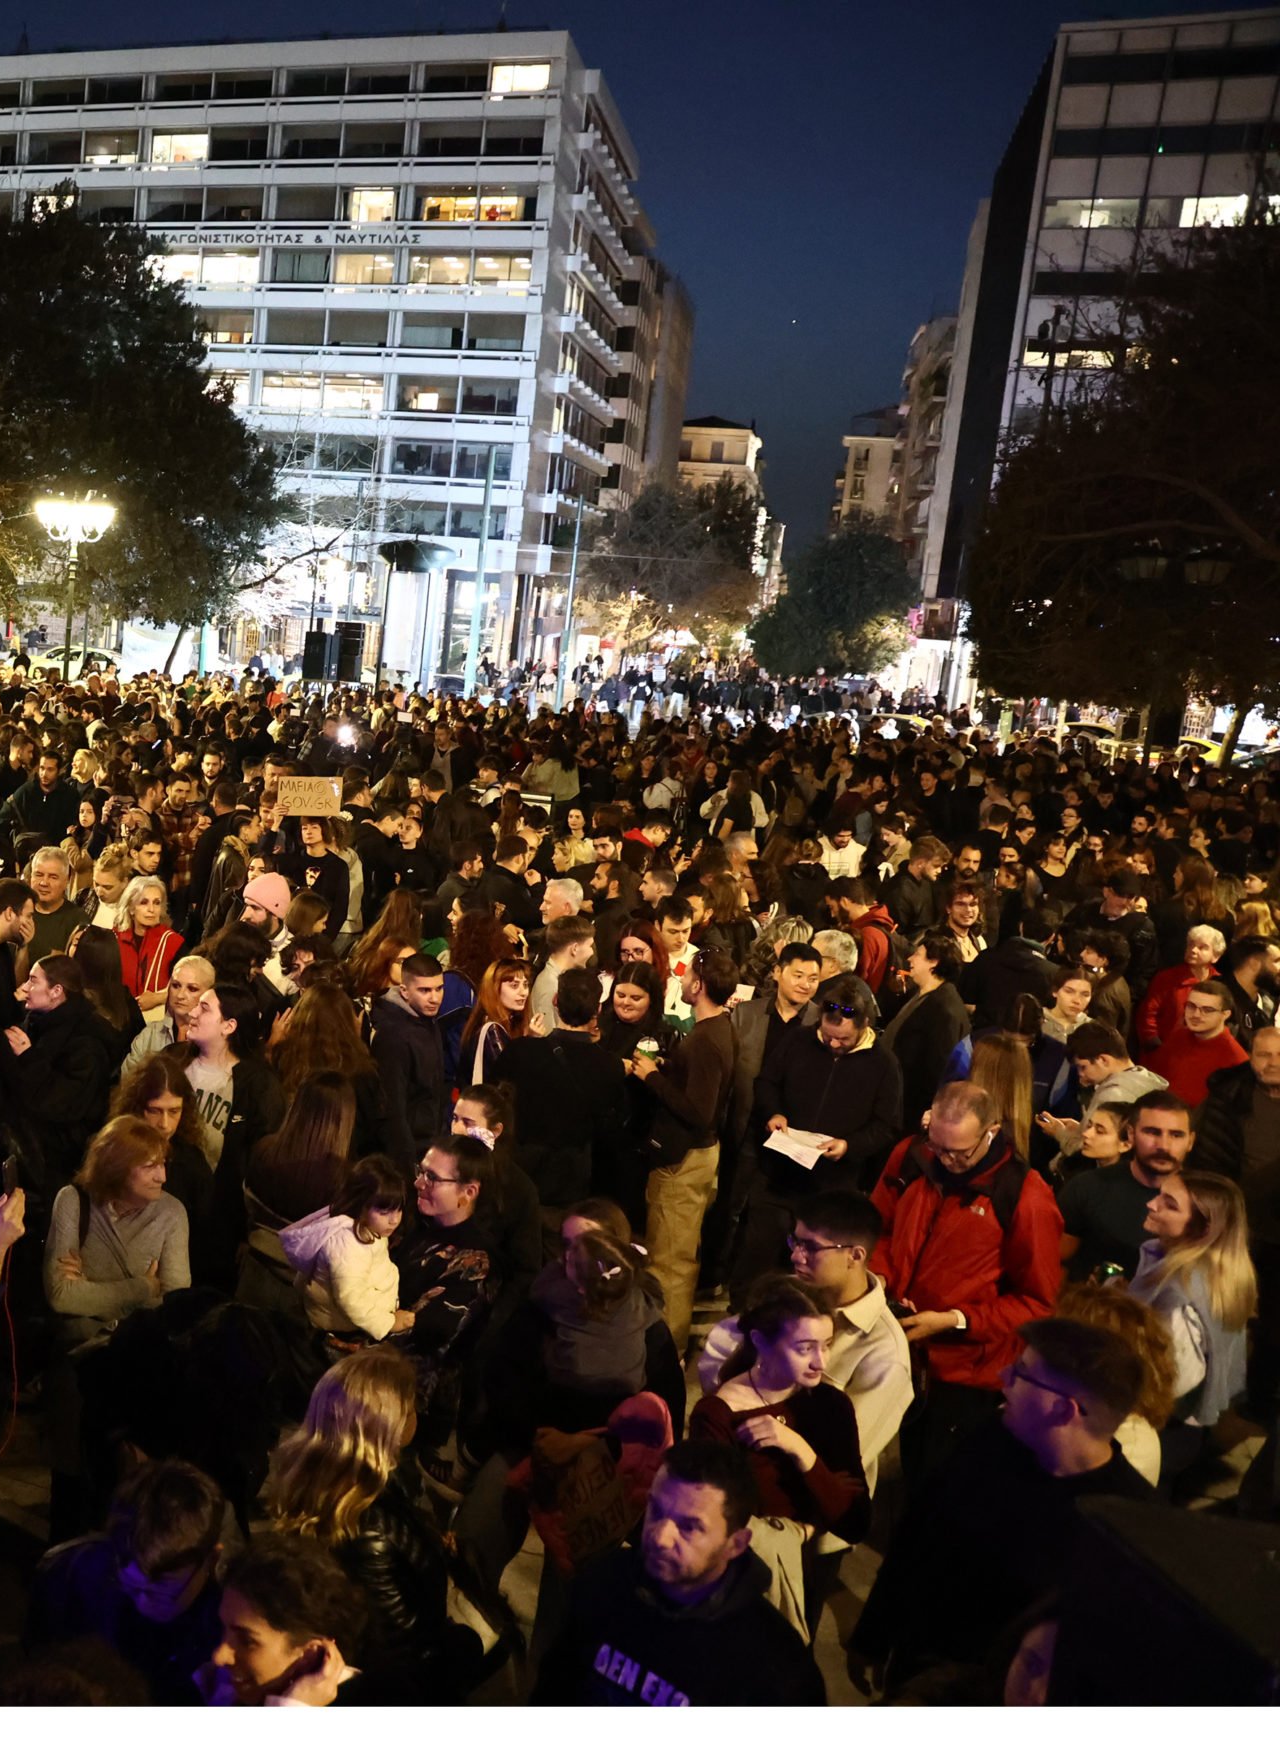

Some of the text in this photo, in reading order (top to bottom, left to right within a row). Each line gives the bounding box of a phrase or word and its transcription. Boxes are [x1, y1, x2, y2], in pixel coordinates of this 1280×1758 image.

[314, 234, 323, 244] &
[335, 233, 421, 244] ΝΑΥΤΙΛΙΑΣ
[282, 796, 333, 810] GOV.GR
